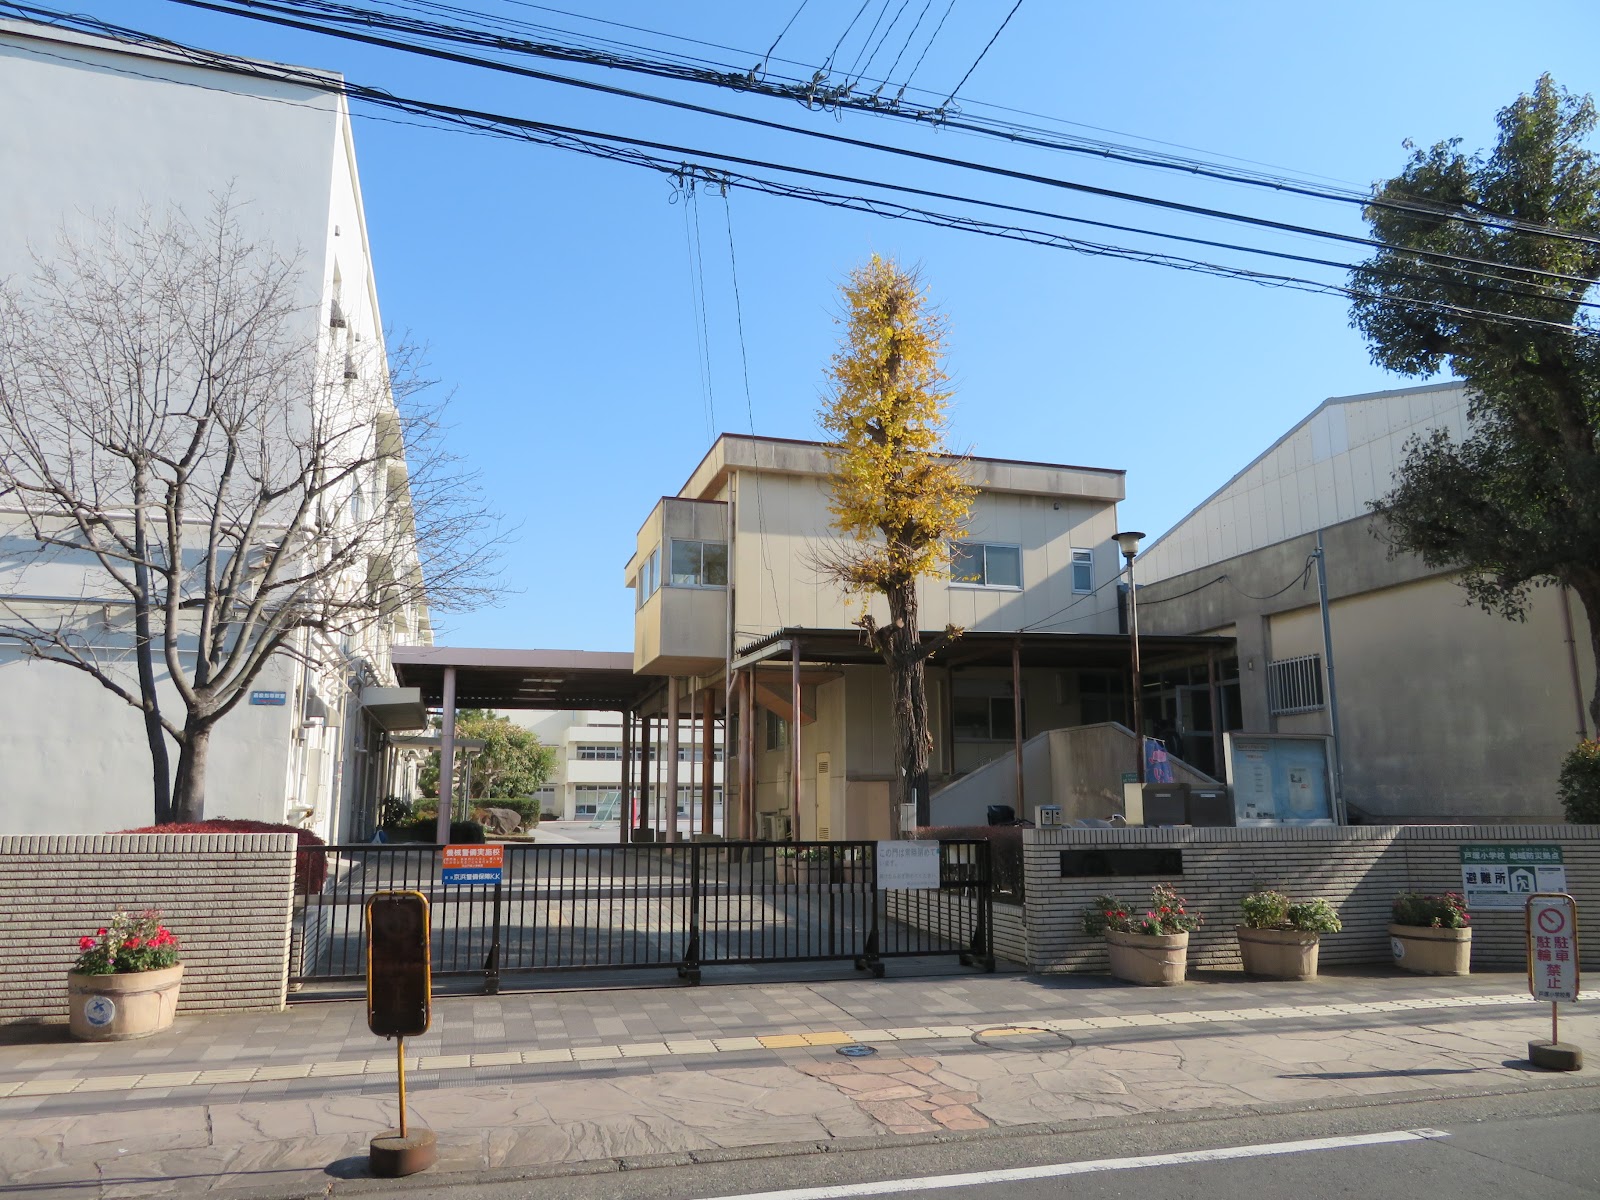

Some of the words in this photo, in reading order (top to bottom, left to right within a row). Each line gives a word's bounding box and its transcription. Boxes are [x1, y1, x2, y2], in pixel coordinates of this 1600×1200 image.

[1463, 851, 1506, 860] 戸塚小学校
[1466, 872, 1506, 885] 避難所
[1536, 935, 1552, 962] 駐輪
[1554, 936, 1570, 962] 駐車
[1546, 963, 1562, 989] 禁止
